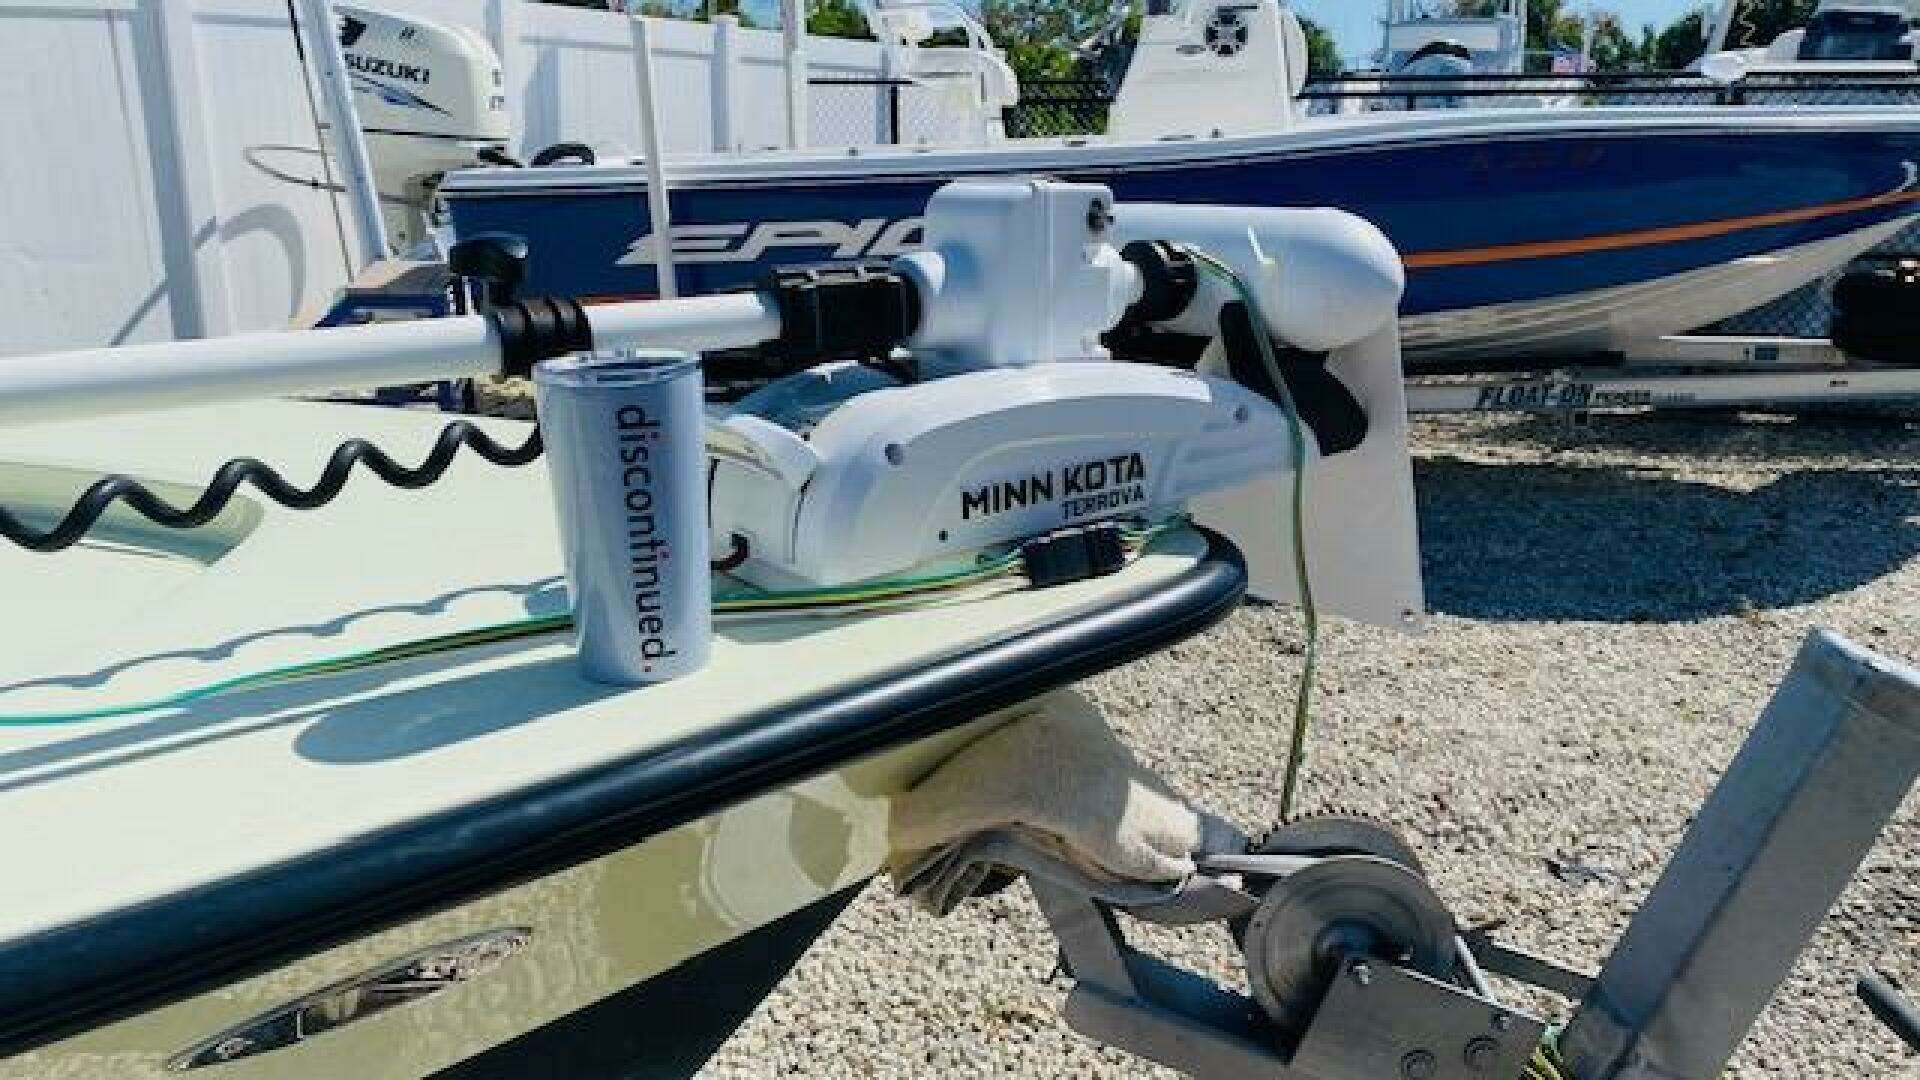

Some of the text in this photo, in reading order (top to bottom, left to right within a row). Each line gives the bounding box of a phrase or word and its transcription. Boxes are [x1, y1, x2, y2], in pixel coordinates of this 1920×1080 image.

[344, 53, 430, 84] SUZUKI
[962, 453, 1145, 520] MINN KOTA
[1062, 486, 1145, 520] TERROVA
[615, 404, 679, 673] discontinued.
